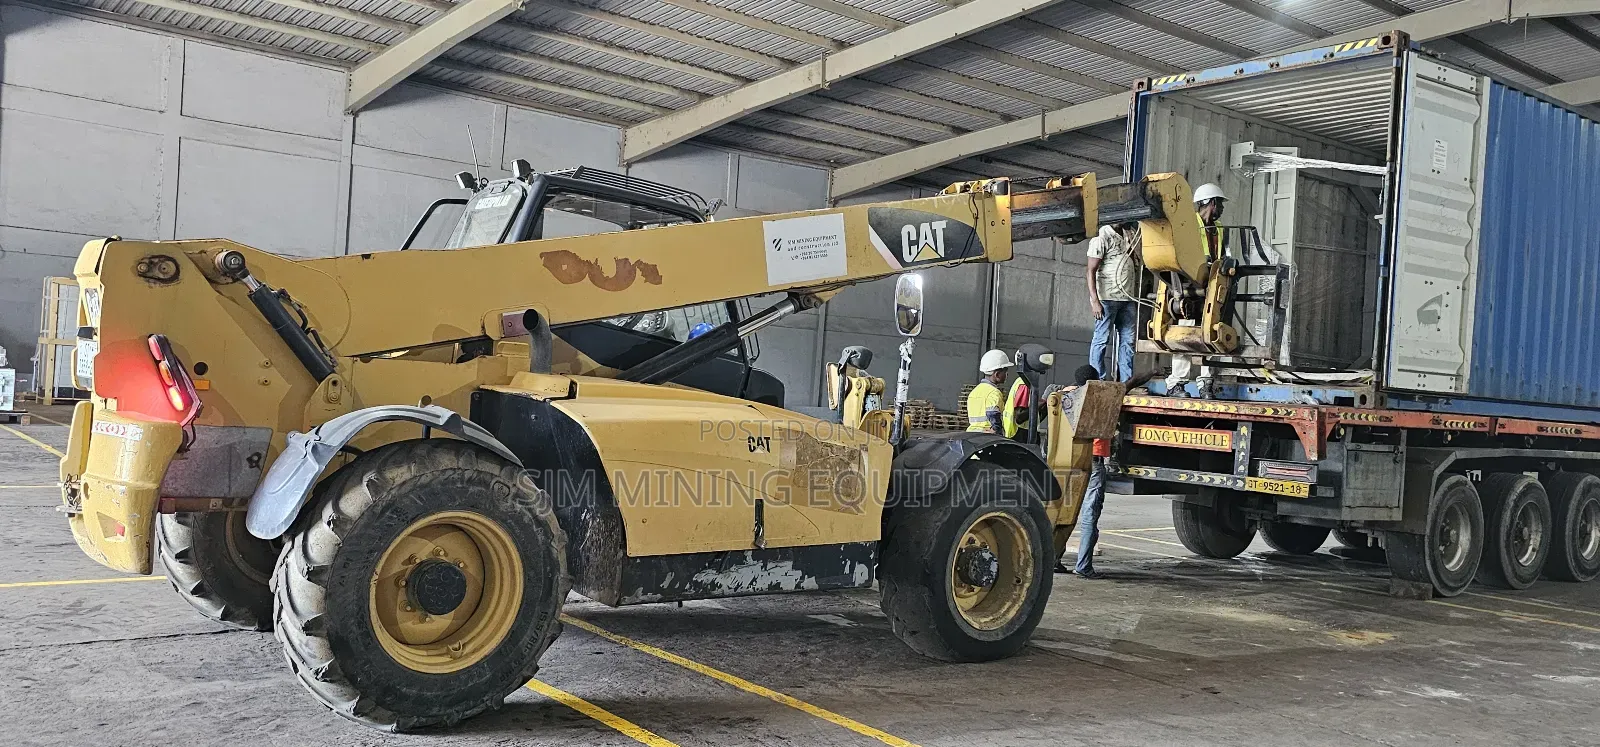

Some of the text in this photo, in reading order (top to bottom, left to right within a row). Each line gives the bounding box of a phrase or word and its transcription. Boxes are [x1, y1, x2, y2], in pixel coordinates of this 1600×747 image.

[901, 220, 948, 263] CAT
[747, 436, 771, 454] CAT
[1138, 428, 1228, 447] LONG VEHICLE
